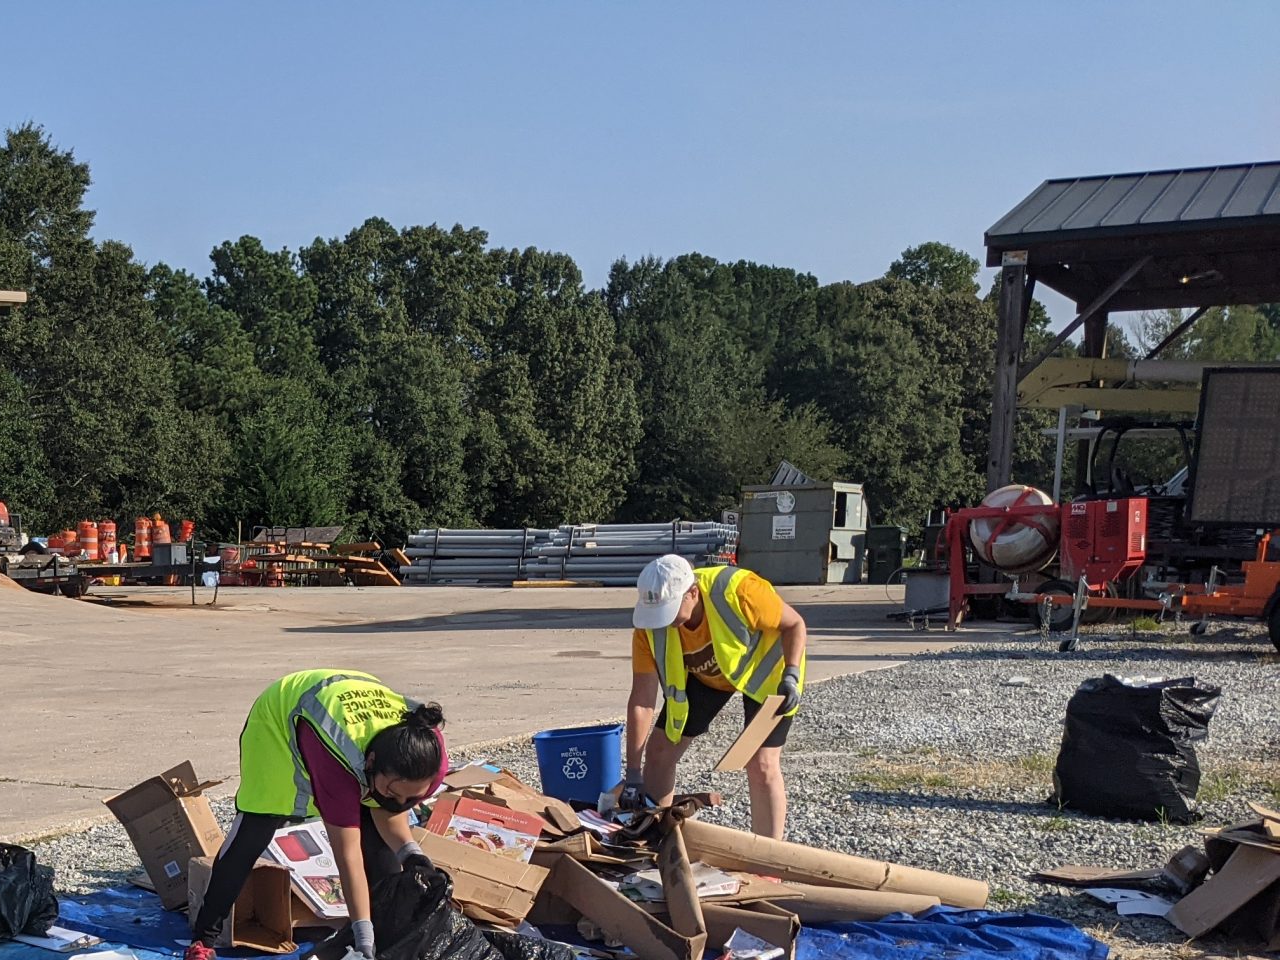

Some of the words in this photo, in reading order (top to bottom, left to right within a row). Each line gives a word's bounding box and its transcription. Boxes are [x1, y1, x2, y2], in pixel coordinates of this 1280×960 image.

[336, 688, 385, 702] WORKER
[343, 699, 391, 713] SERVICE
[560, 750, 587, 758] RECYCLE
